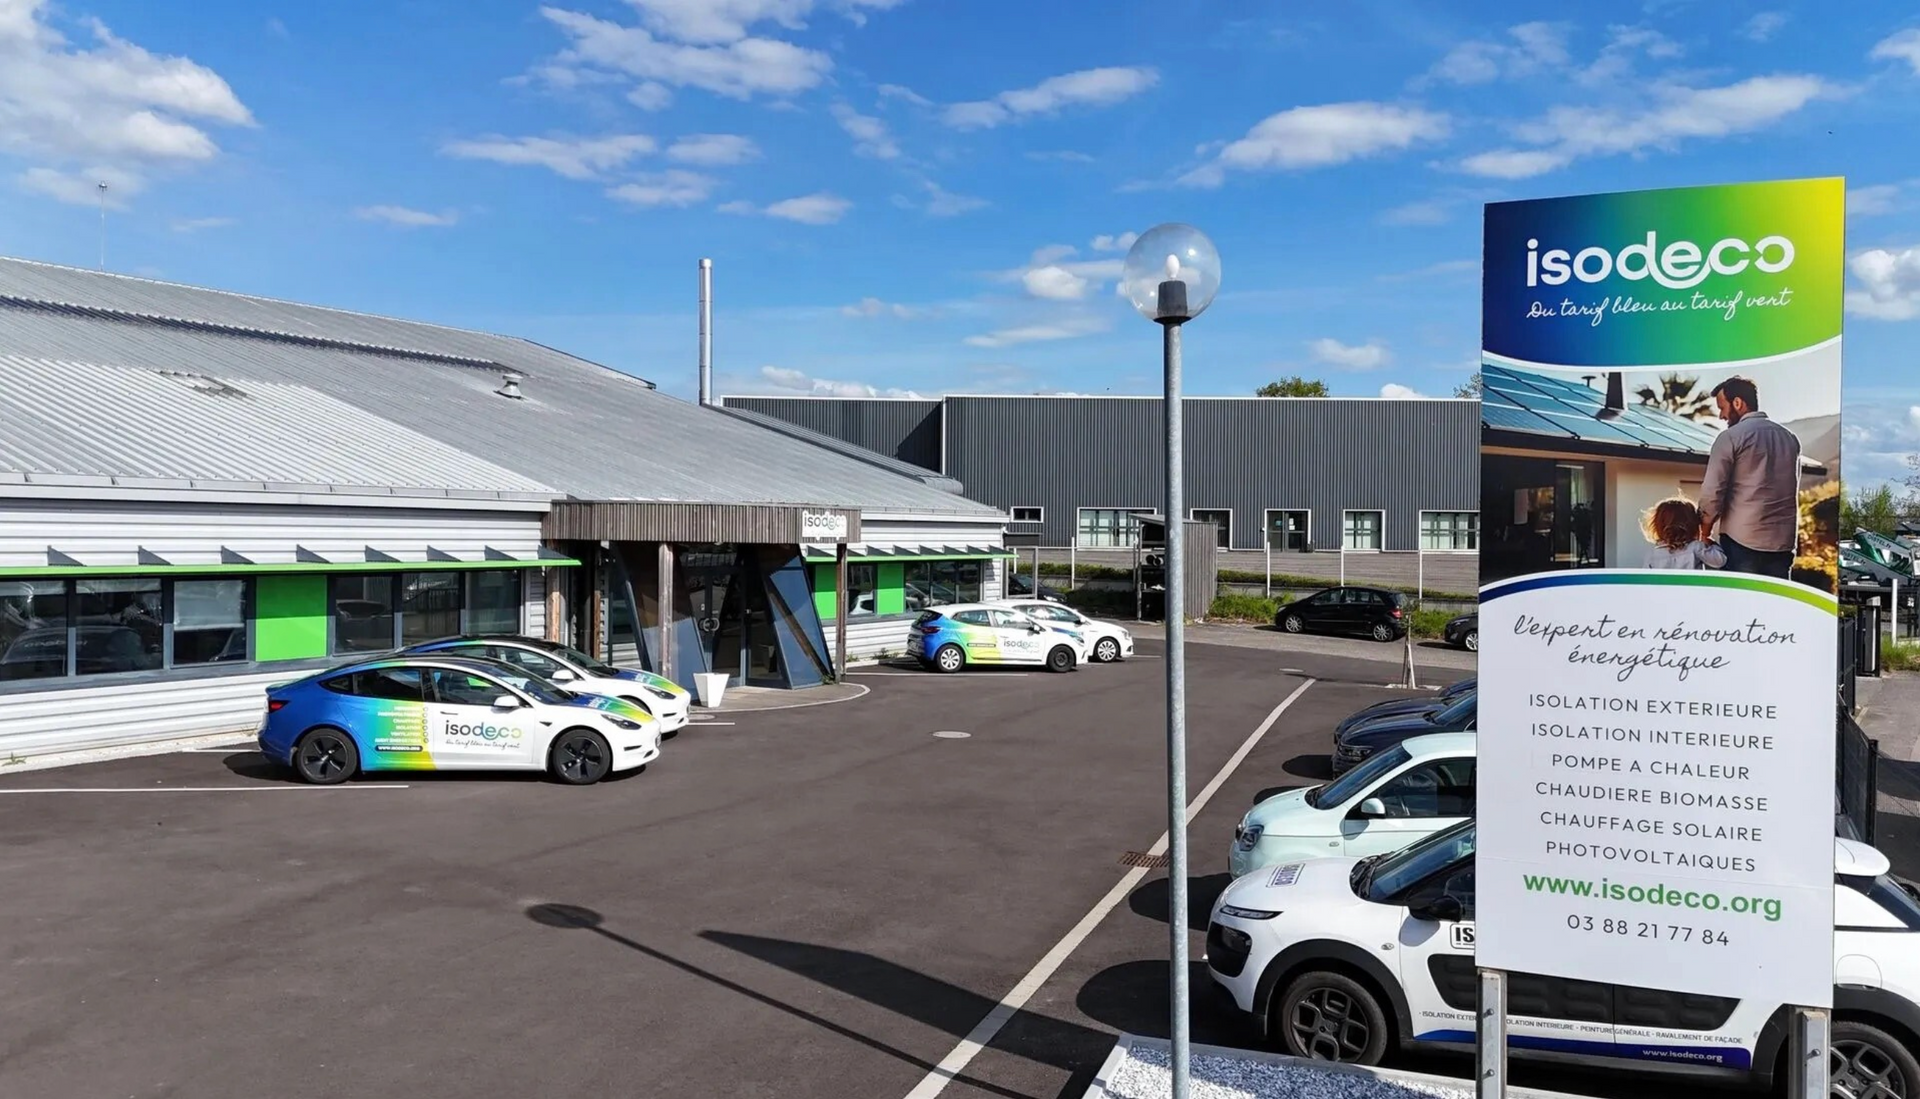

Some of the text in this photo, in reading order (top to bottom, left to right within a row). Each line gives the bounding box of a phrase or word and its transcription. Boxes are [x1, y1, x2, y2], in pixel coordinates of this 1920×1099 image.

[1526, 230, 1796, 290] isodeco
[1526, 287, 1793, 329] Du tarif bleu au tarif vert
[1003, 638, 1040, 649] isodeco
[1513, 614, 1797, 647] l'expert en rénovation
[1567, 643, 1731, 683] énergétique
[1529, 693, 1777, 720] ISOLATION EXTERIEURE
[445, 720, 522, 741] isodeco
[1532, 723, 1773, 750] ISOLATION INTERIEURE
[1552, 753, 1749, 780] POMPE A CHALEUR
[1535, 781, 1768, 812] CHAUDIERE BIOMASSE
[1540, 811, 1762, 842] CHAUFFAGE SOLAIRE
[1546, 840, 1757, 872] PHOTOVOLTAIQUES
[1522, 873, 1783, 922] www.isodeco.org
[1567, 914, 1729, 947] 03 88 21 77 84
[1422, 1011, 1456, 1020] ISOLATION
[1456, 1013, 1477, 1021] EXTER
[1506, 1018, 1535, 1027] OLATION
[1536, 1021, 1574, 1030] INTERIEURE
[1580, 1026, 1614, 1034] PEINTURE
[1615, 1027, 1651, 1037] GÉNÉRALE
[1656, 1031, 1702, 1041] RAVALEMENT
[1714, 1036, 1743, 1044] FAÇADE
[1642, 1049, 1723, 1063] www.isodeco.org
